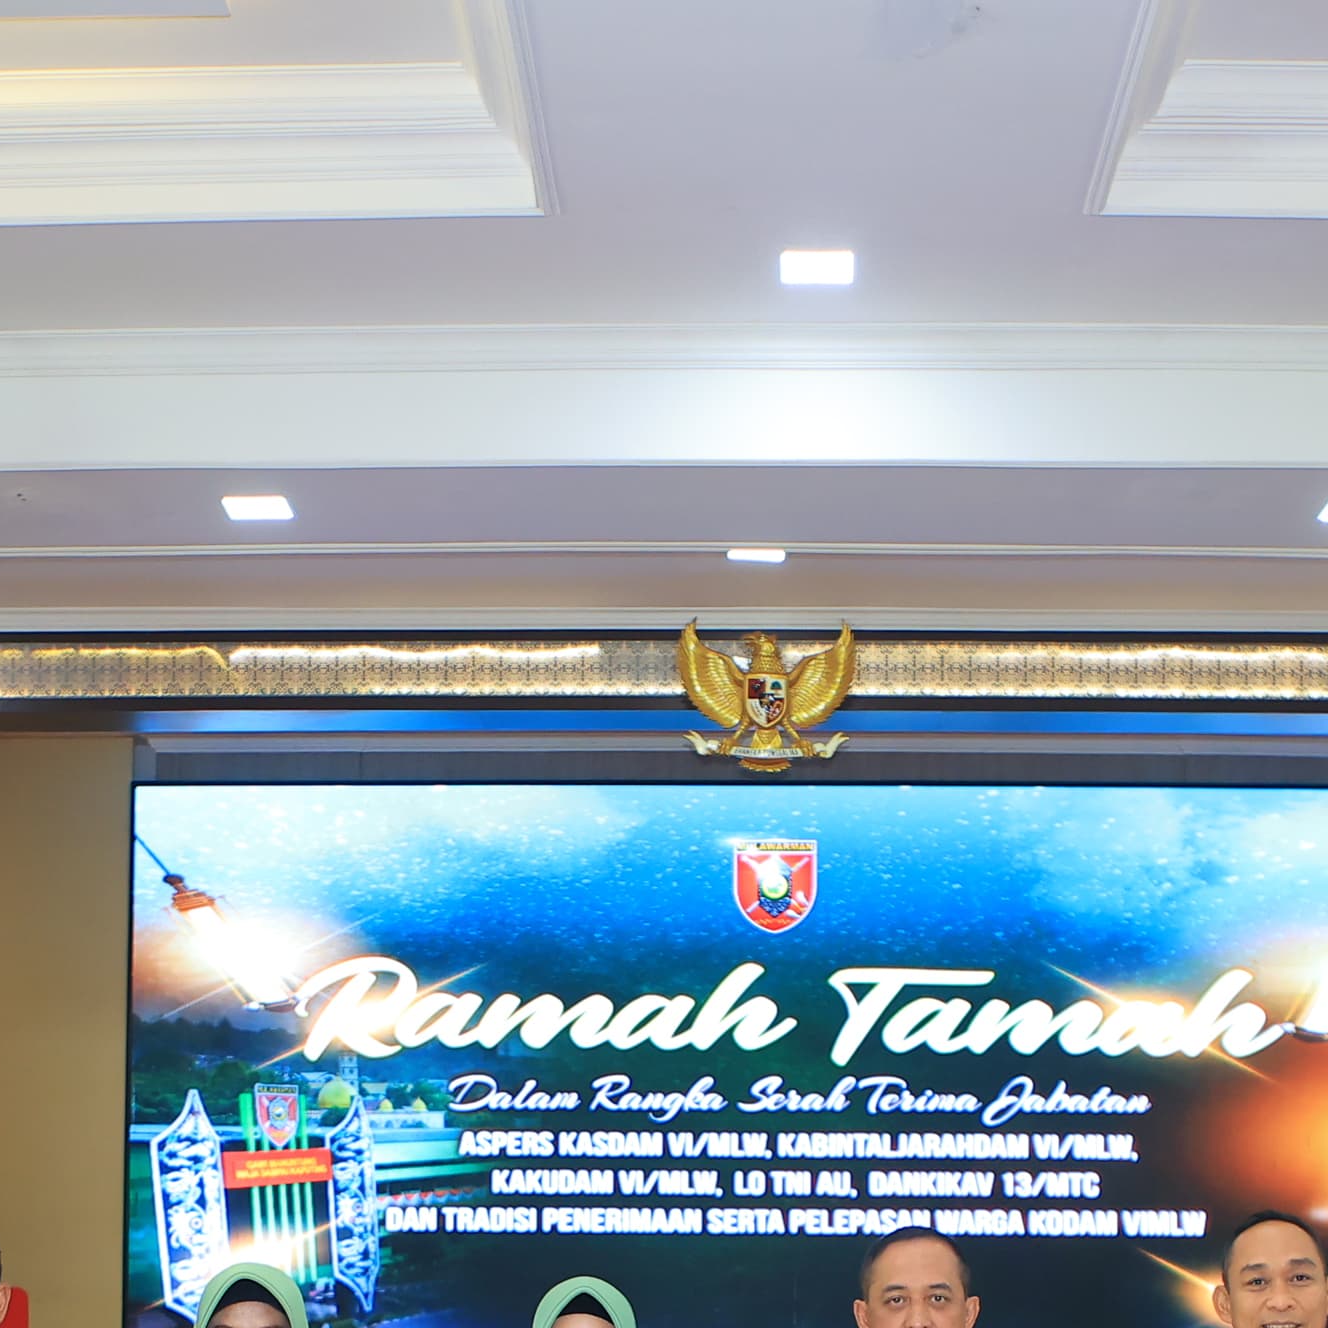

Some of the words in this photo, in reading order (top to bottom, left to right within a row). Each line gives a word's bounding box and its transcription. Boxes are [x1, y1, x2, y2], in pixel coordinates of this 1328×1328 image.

[294, 956, 798, 1062] Ramah
[828, 967, 1285, 1066] Tamah
[447, 1073, 582, 1113] Dalam
[588, 1073, 730, 1124] Rangka
[736, 1074, 855, 1114] Serah
[856, 1076, 981, 1114] Terima
[980, 1076, 1153, 1127] Jabatan
[458, 1131, 556, 1158] ASPERS
[557, 1131, 664, 1158] KASDAM
[668, 1132, 773, 1160] VI/MLW,
[1032, 1133, 1140, 1162] VI/MLW,
[490, 1168, 615, 1195] KAKUDAM
[617, 1169, 724, 1198] VI/MLW,
[733, 1170, 766, 1196] LO
[769, 1170, 811, 1197] TNI
[814, 1171, 858, 1198] AU,
[867, 1171, 995, 1198] DANKIKAV
[1001, 1171, 1102, 1199] 13/MTC
[384, 1205, 438, 1233] DAN
[440, 1206, 537, 1234] TRADISI
[541, 1206, 703, 1235] PENERIMAAN
[705, 1207, 786, 1235] SERTA
[788, 1208, 932, 1236] PELEPASAN
[933, 1209, 1026, 1237] WARGA
[1027, 1209, 1119, 1237] KODAM
